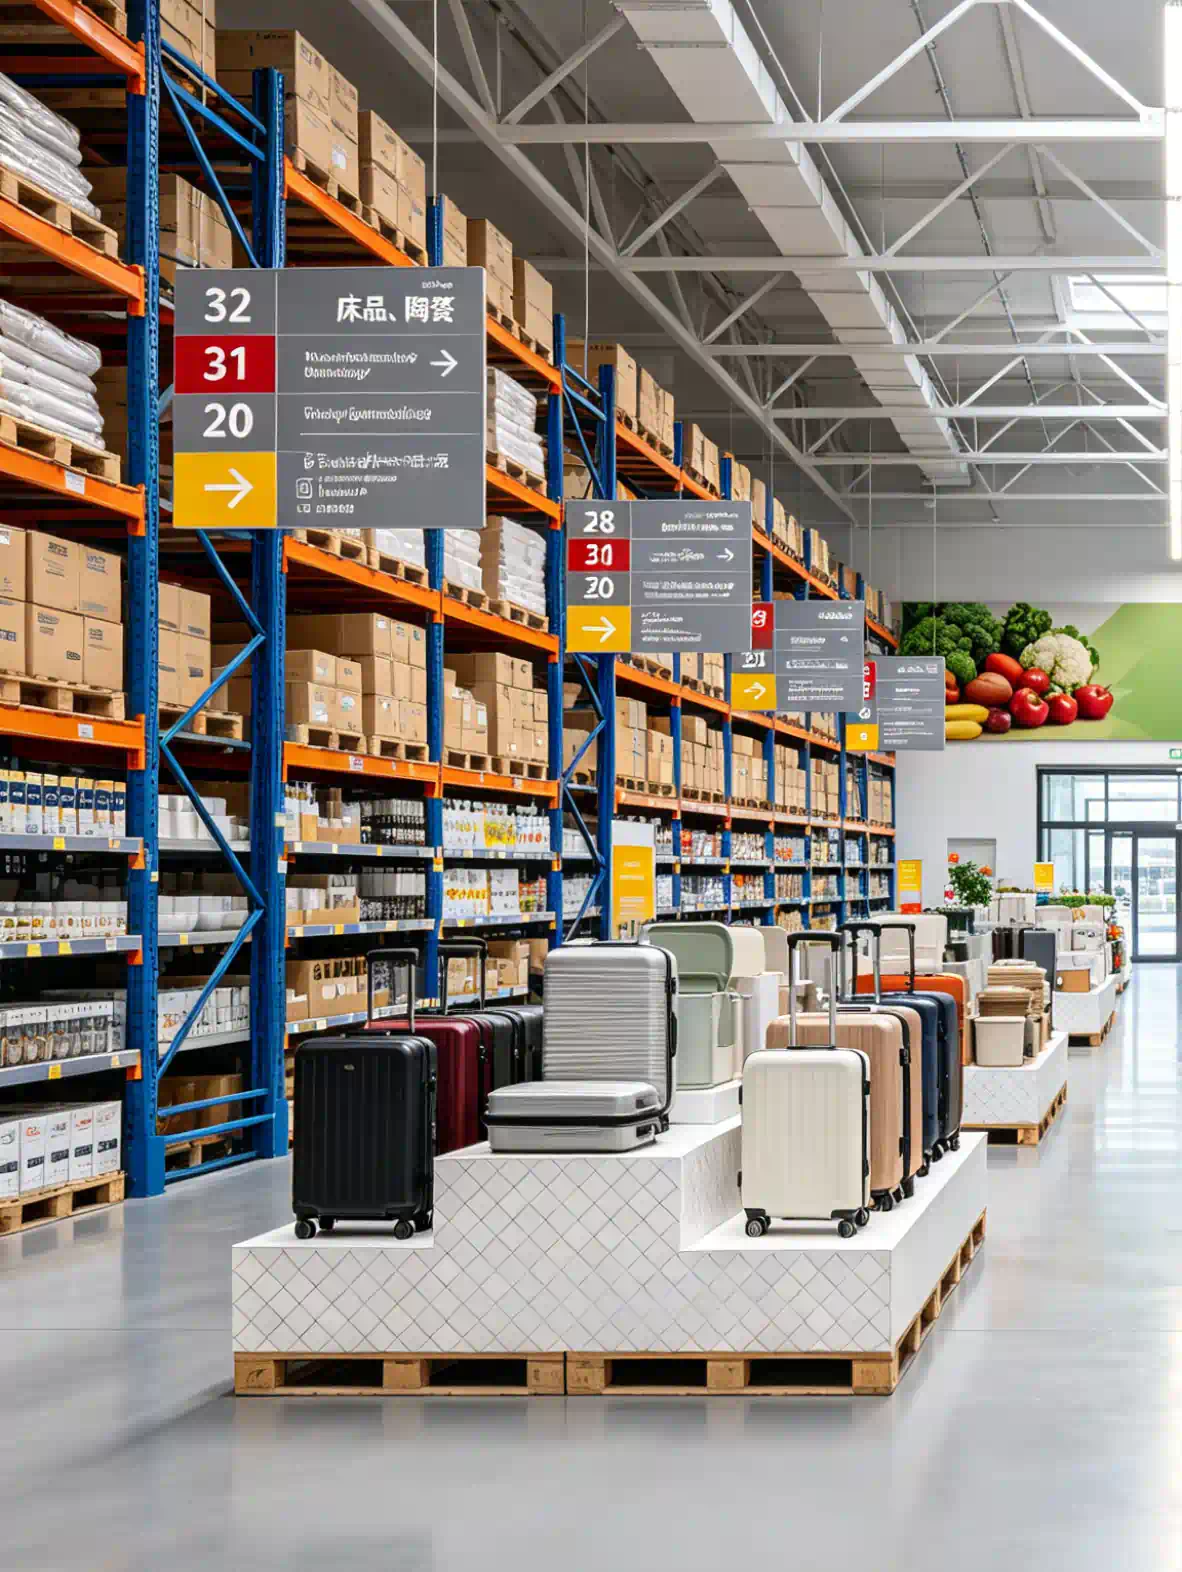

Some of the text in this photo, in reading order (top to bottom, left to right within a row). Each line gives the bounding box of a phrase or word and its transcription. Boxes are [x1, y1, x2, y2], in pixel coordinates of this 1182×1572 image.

[203, 287, 252, 323] 32
[203, 346, 246, 381] 31
[202, 402, 254, 439] 20
[583, 510, 616, 534] 28
[584, 543, 613, 566] 30
